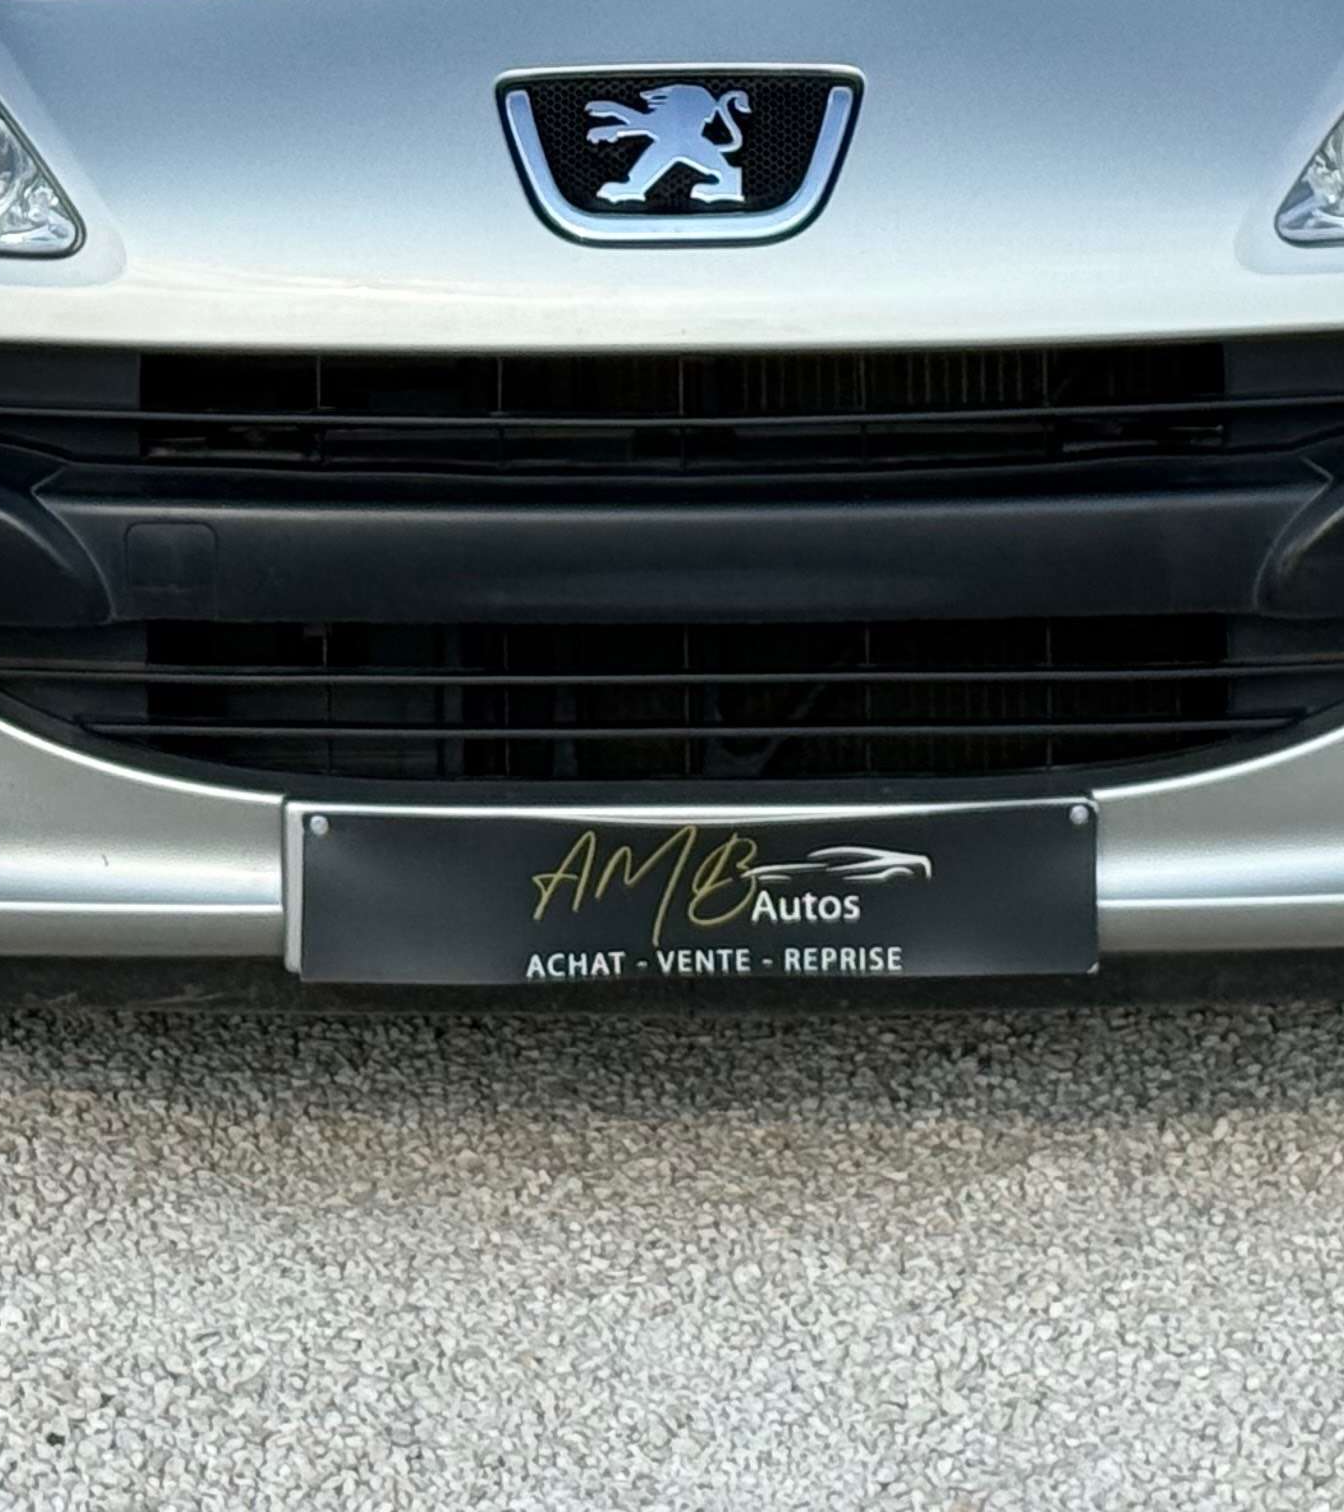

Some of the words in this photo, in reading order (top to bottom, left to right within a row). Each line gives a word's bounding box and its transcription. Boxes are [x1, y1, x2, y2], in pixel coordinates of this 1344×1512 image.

[531, 824, 757, 948] AMB
[751, 889, 862, 923] Autos
[525, 950, 626, 979] ACHAT
[656, 948, 752, 974] VENTE
[783, 945, 904, 973] REPRISE
